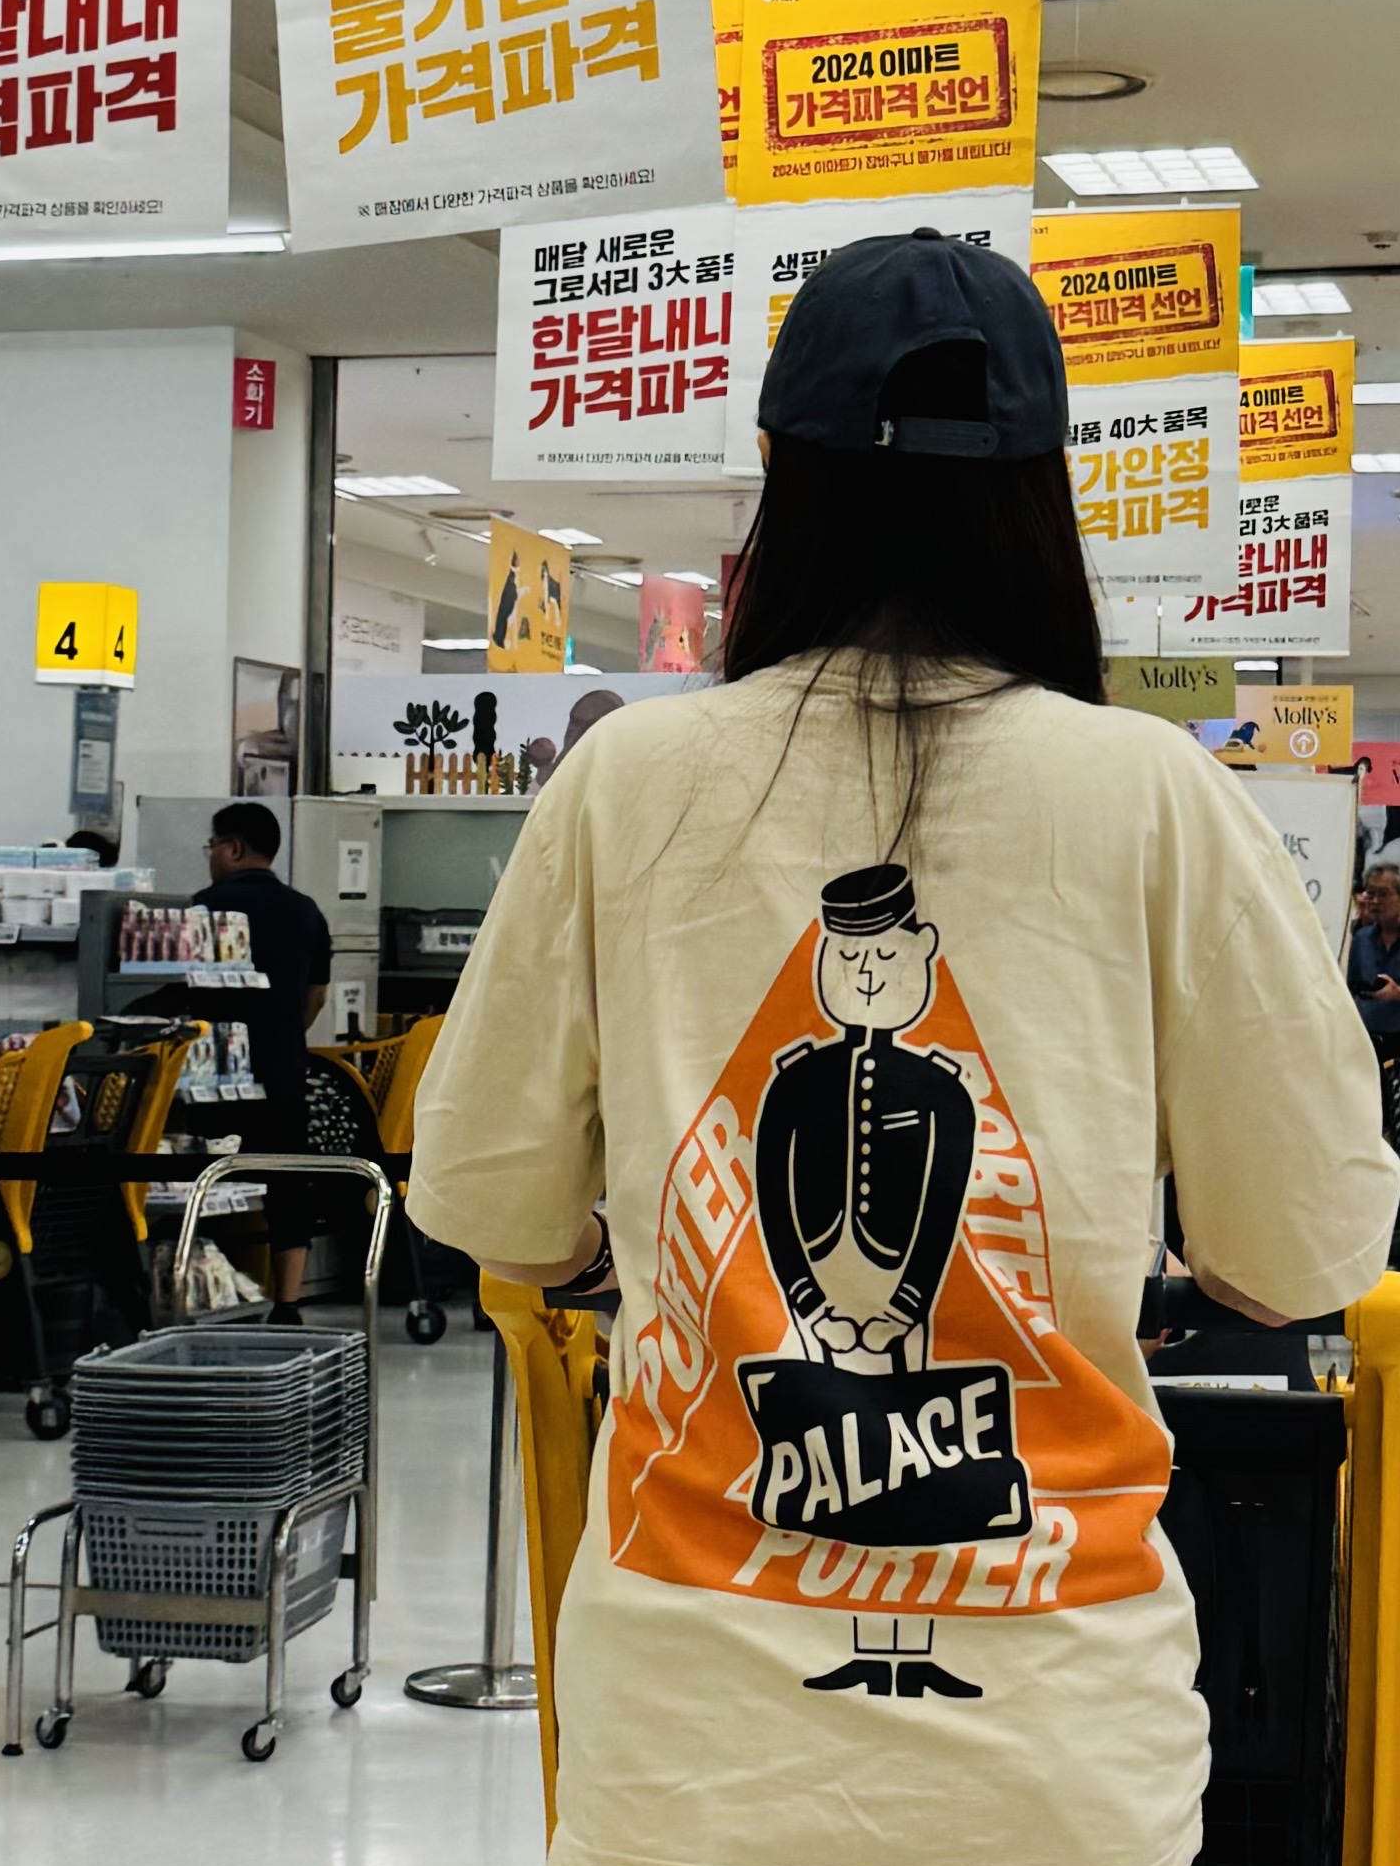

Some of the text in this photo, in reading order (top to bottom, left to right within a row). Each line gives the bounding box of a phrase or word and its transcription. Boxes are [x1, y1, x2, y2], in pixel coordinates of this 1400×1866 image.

[812, 43, 960, 83] 2024 이마트
[786, 76, 990, 128] 가격파격 선언
[535, 229, 674, 273] 매달 새로운
[533, 260, 690, 306] 그로서리 3大
[1061, 263, 1178, 297] 2024 이마트
[1151, 288, 1202, 318] 선언
[244, 363, 265, 425] 소화기
[1254, 385, 1305, 406] 이마트
[1110, 414, 1157, 440] 40大
[1164, 407, 1207, 433] 품목
[1283, 406, 1323, 430] 선언
[1263, 515, 1290, 533] 3大
[54, 622, 78, 660] 4
[114, 625, 125, 663] 4
[1139, 665, 1218, 692] Molly's
[1273, 706, 1338, 729] Molly's
[637, 1095, 752, 1448] PORTER
[762, 1377, 1002, 1526] PALACE
[731, 1506, 1077, 1607] PORTER
